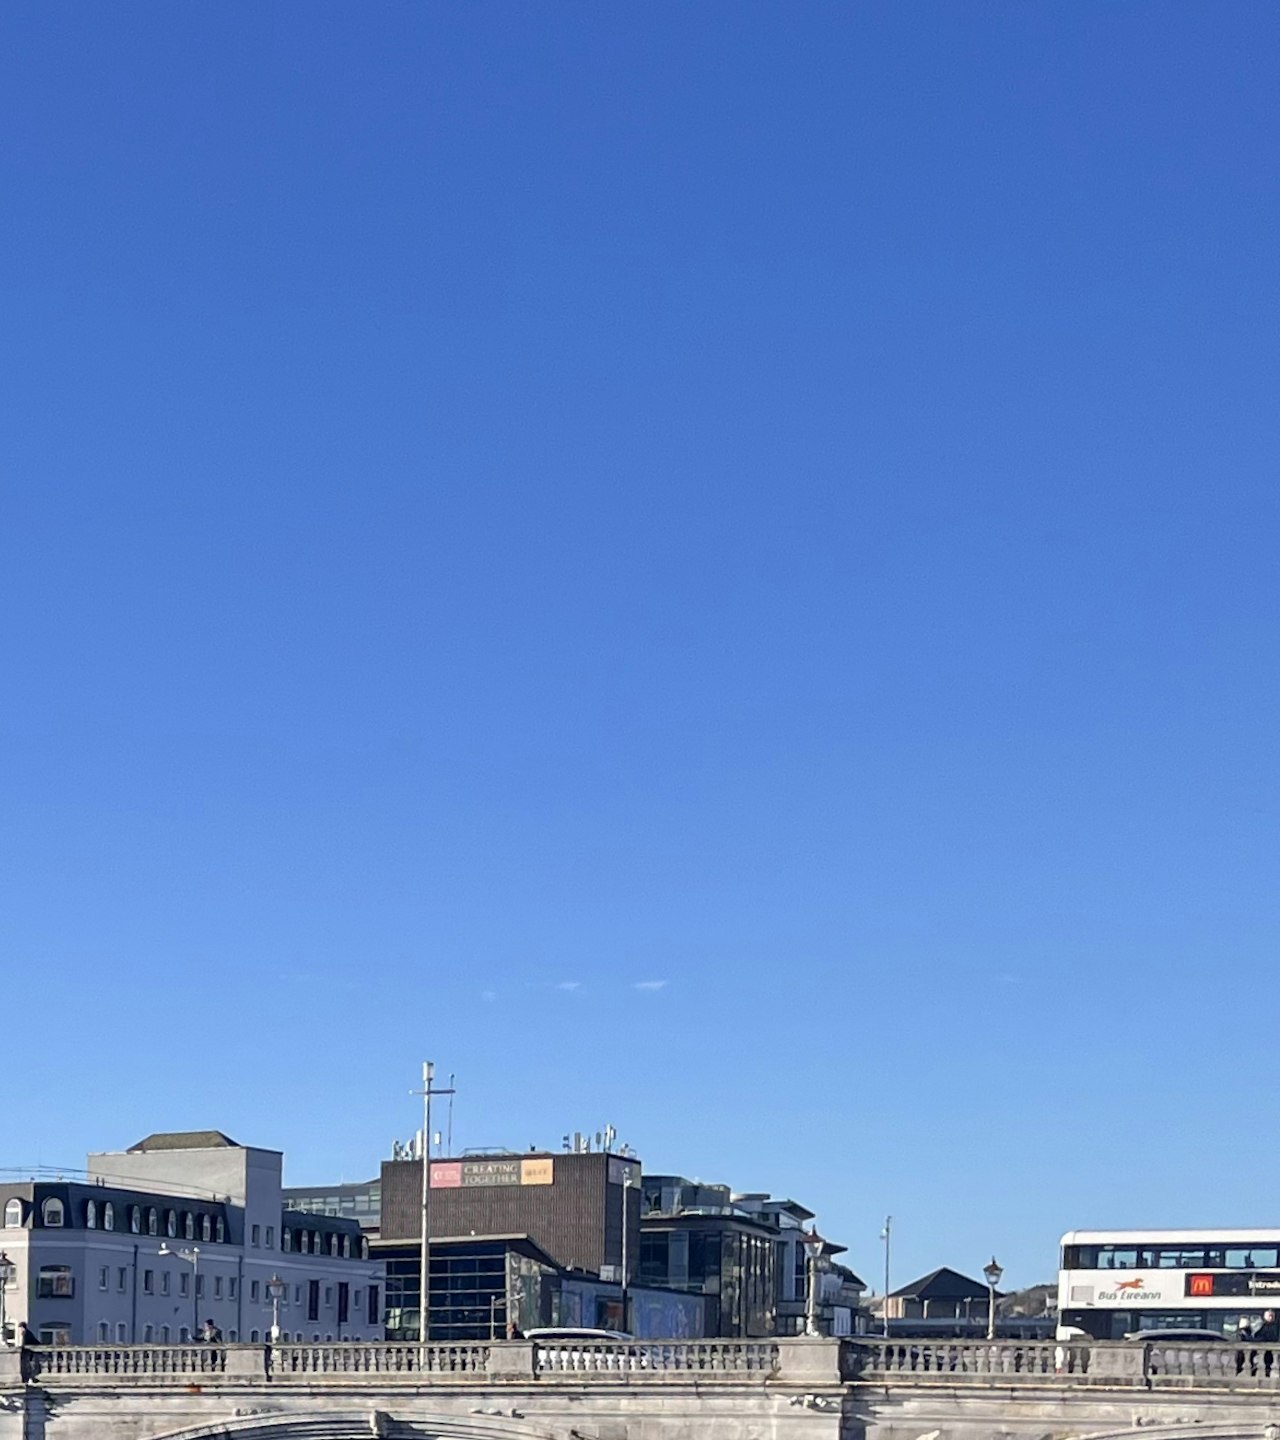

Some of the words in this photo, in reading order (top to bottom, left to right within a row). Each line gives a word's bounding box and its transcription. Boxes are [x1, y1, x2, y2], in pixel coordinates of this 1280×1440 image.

[464, 1164, 517, 1174] CREATING
[465, 1174, 517, 1184] TOGETHER
[1098, 1290, 1118, 1300] Bus
[1120, 1288, 1161, 1300] Éireann
